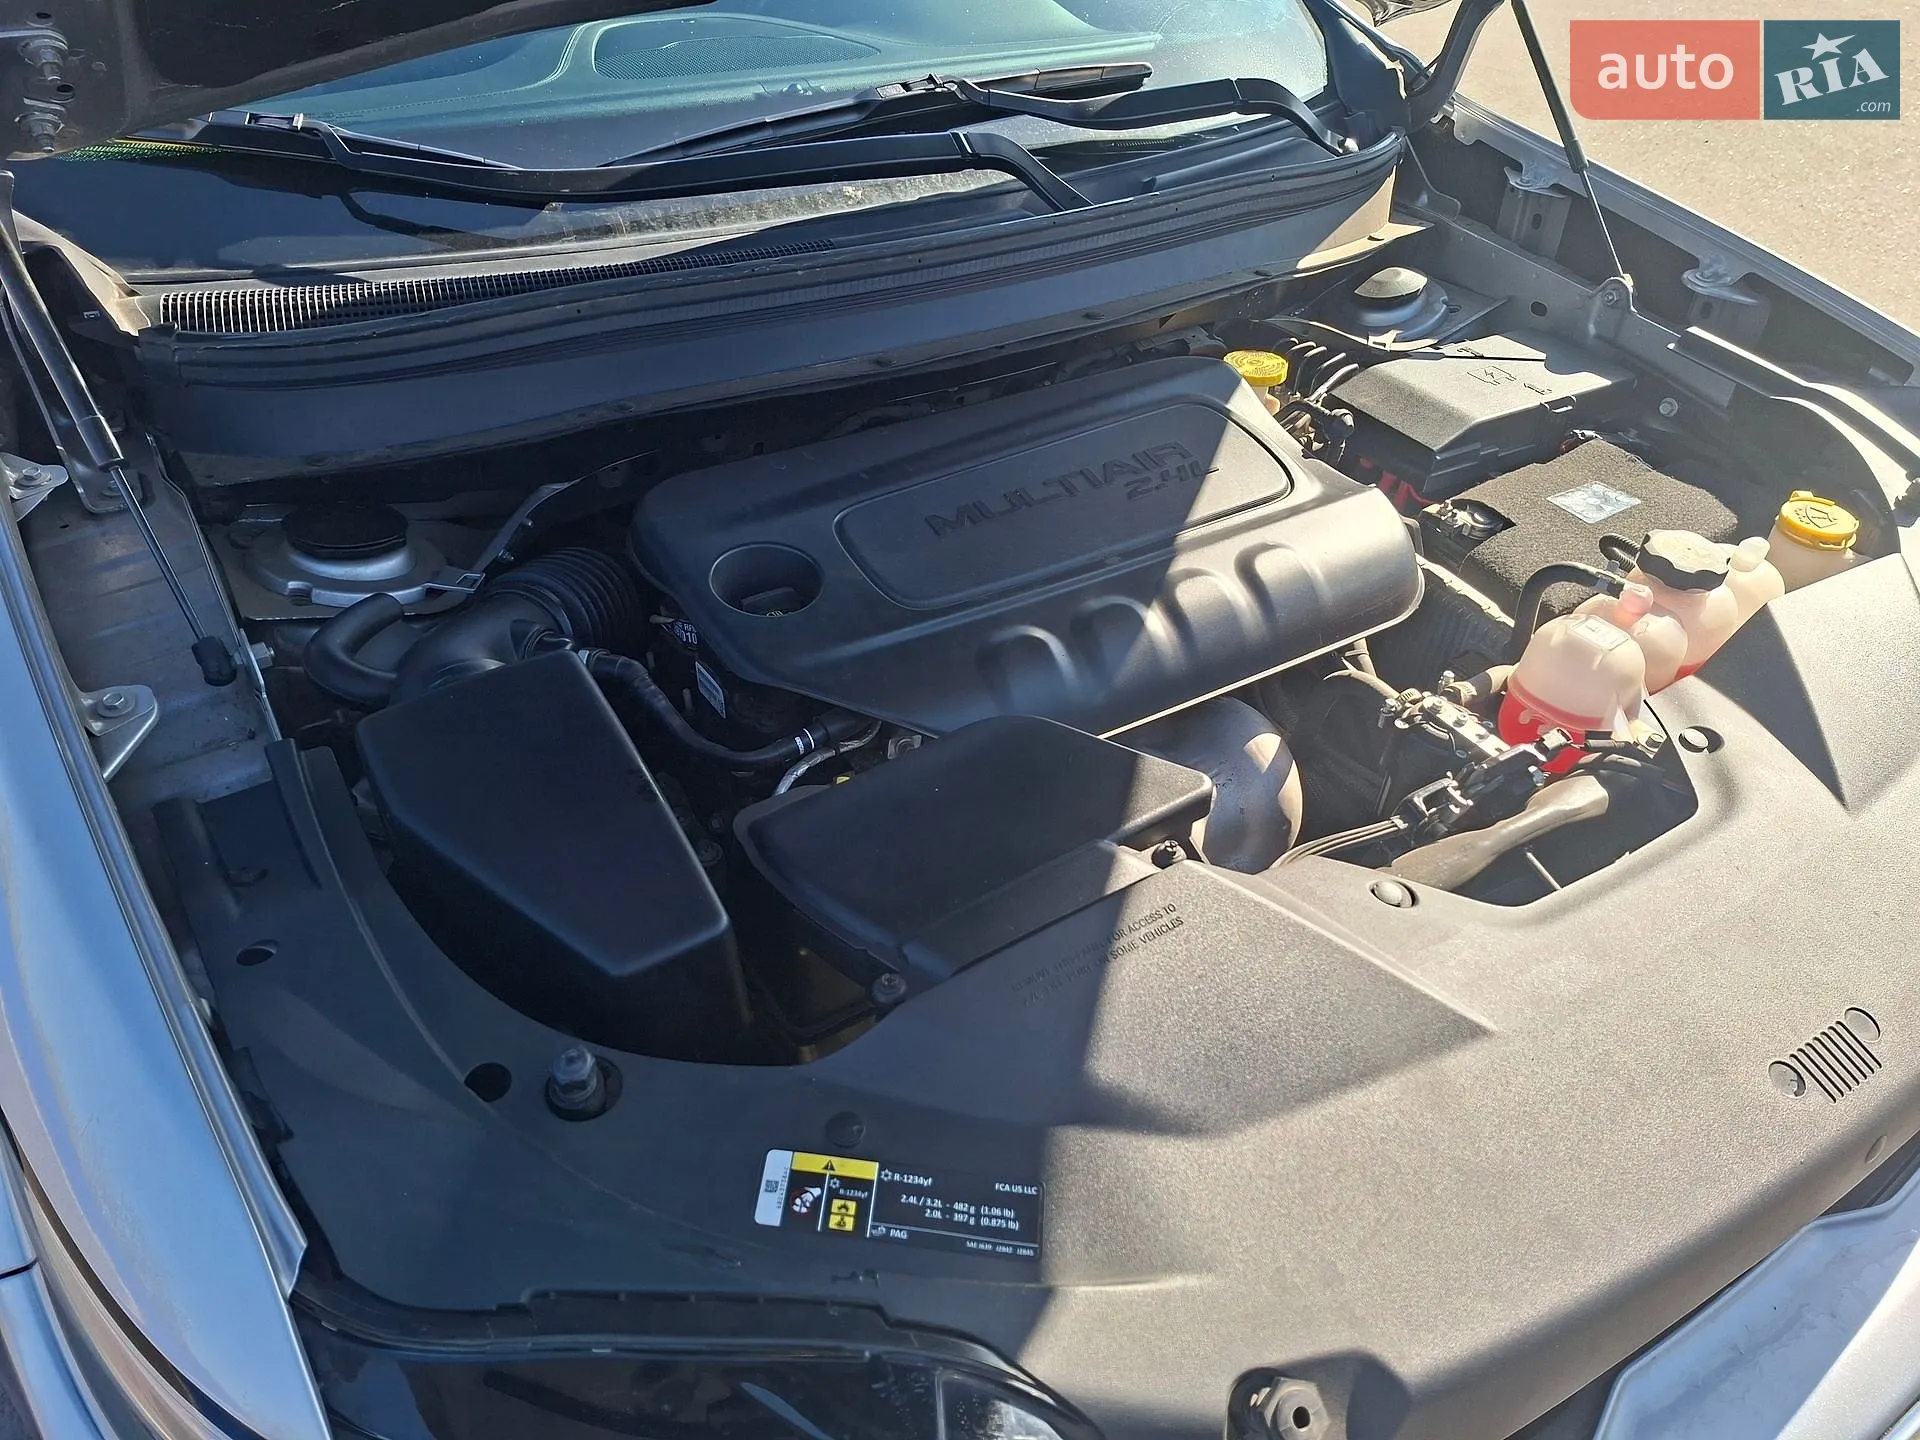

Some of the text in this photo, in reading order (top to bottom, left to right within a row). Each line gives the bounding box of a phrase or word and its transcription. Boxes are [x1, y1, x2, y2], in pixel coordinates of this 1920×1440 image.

[924, 440, 1194, 537] MULTIAIR
[1128, 909, 1163, 934] ACCESS
[1111, 939, 1139, 960] SOME
[1140, 916, 1184, 944] VEHICLES
[893, 1173, 932, 1187] R-1234yf
[995, 1182, 1039, 1195] FCA US LLC
[900, 1194, 918, 1205] 2.4L
[953, 1201, 968, 1212] 482
[981, 1204, 1002, 1215] (1.06
[925, 1209, 942, 1219] 2.0L
[890, 1228, 908, 1239] PAG
